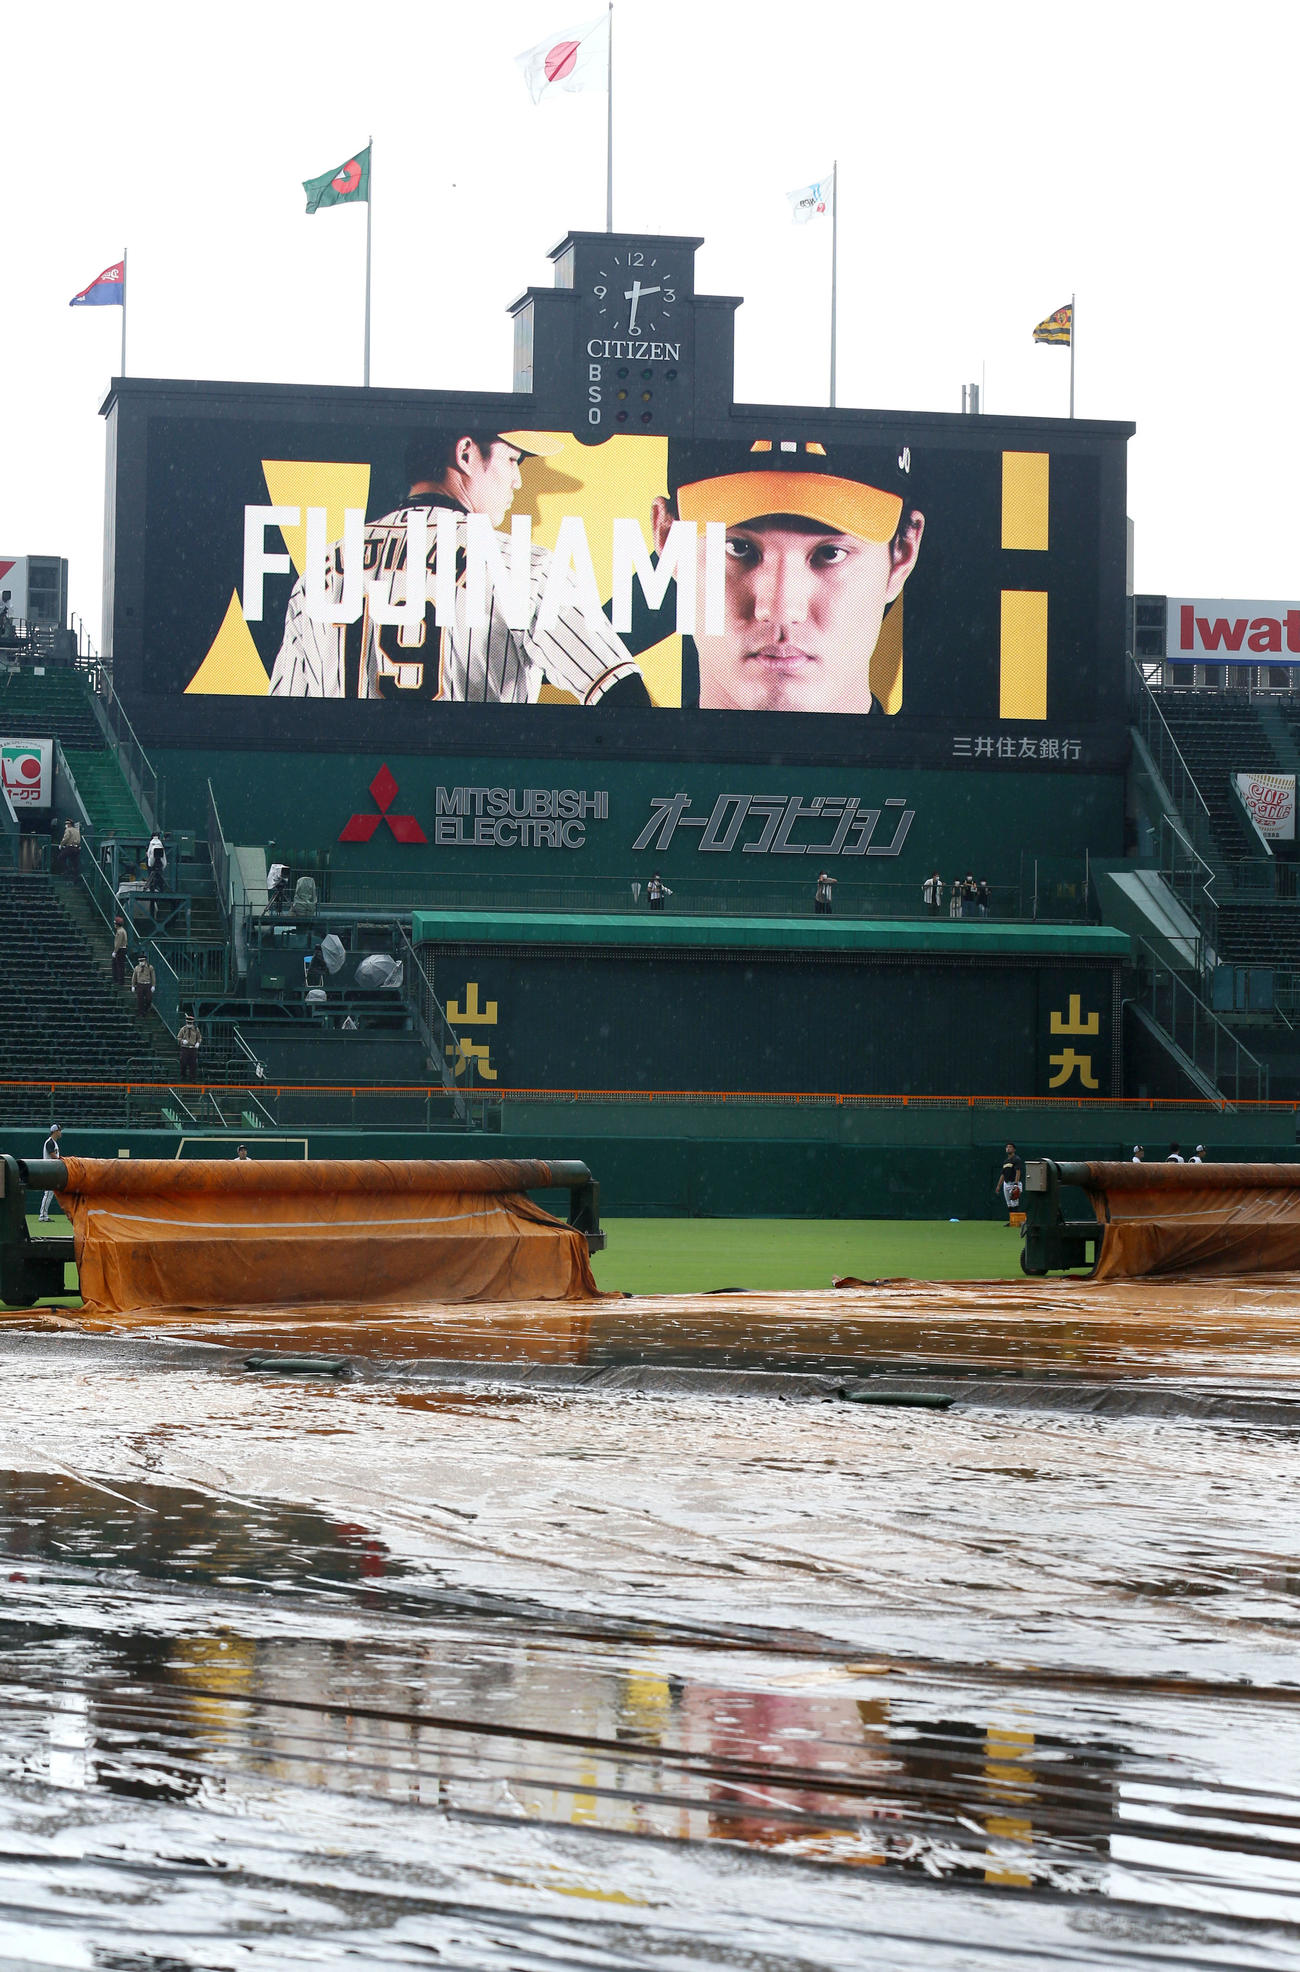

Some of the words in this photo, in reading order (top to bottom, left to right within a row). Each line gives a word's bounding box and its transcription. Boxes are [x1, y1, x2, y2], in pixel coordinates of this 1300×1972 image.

[627, 252, 644, 267] 12
[593, 285, 608, 300] 9
[663, 289, 676, 303] 3
[628, 324, 642, 337] 6
[586, 338, 681, 361] CITIZEN
[589, 364, 602, 382] B
[588, 386, 602, 403] S
[588, 407, 601, 425] O
[243, 504, 727, 636] FUJINAMI
[952, 736, 1082, 760] 三井住友銀行
[435, 786, 609, 819] MITSUBISHI
[434, 819, 586, 849] ELECTRIC
[632, 793, 916, 856] オーロラビジョン
[446, 982, 498, 1081] 山九
[1048, 994, 1100, 1090] 山九
